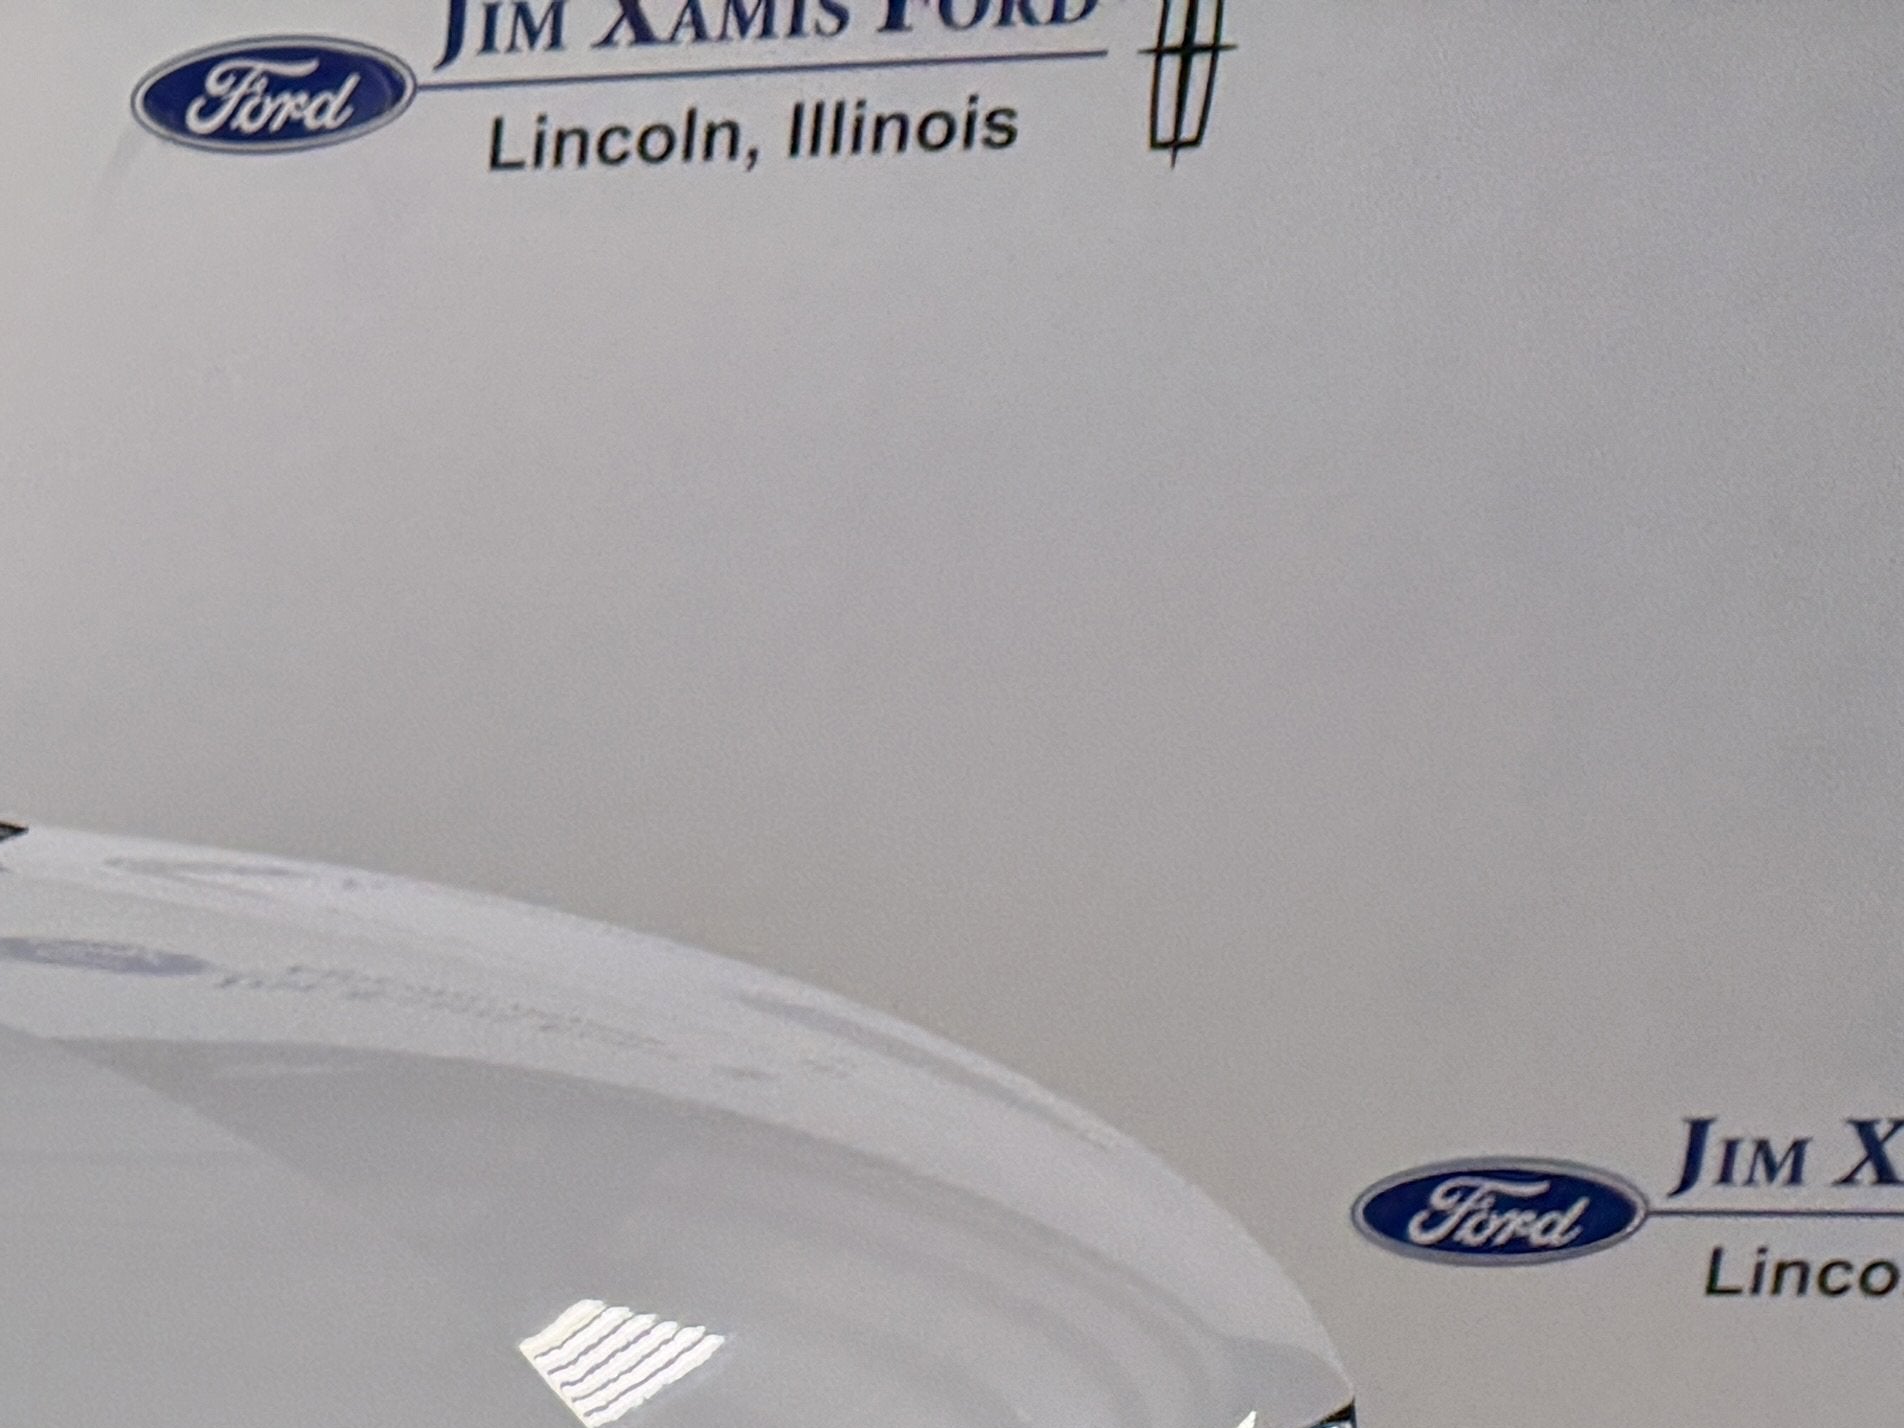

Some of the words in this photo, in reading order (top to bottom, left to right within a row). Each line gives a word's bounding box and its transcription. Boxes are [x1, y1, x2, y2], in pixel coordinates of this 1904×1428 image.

[433, 0, 570, 71] JIM
[591, 0, 852, 48] XAMIS
[185, 58, 360, 134] Ford
[489, 107, 759, 173] Lincoln,
[789, 94, 1019, 158] Illinois
[1666, 1117, 1813, 1198] JIM
[1407, 1176, 1590, 1248] Ford
[1705, 1246, 1904, 1297] Linco
